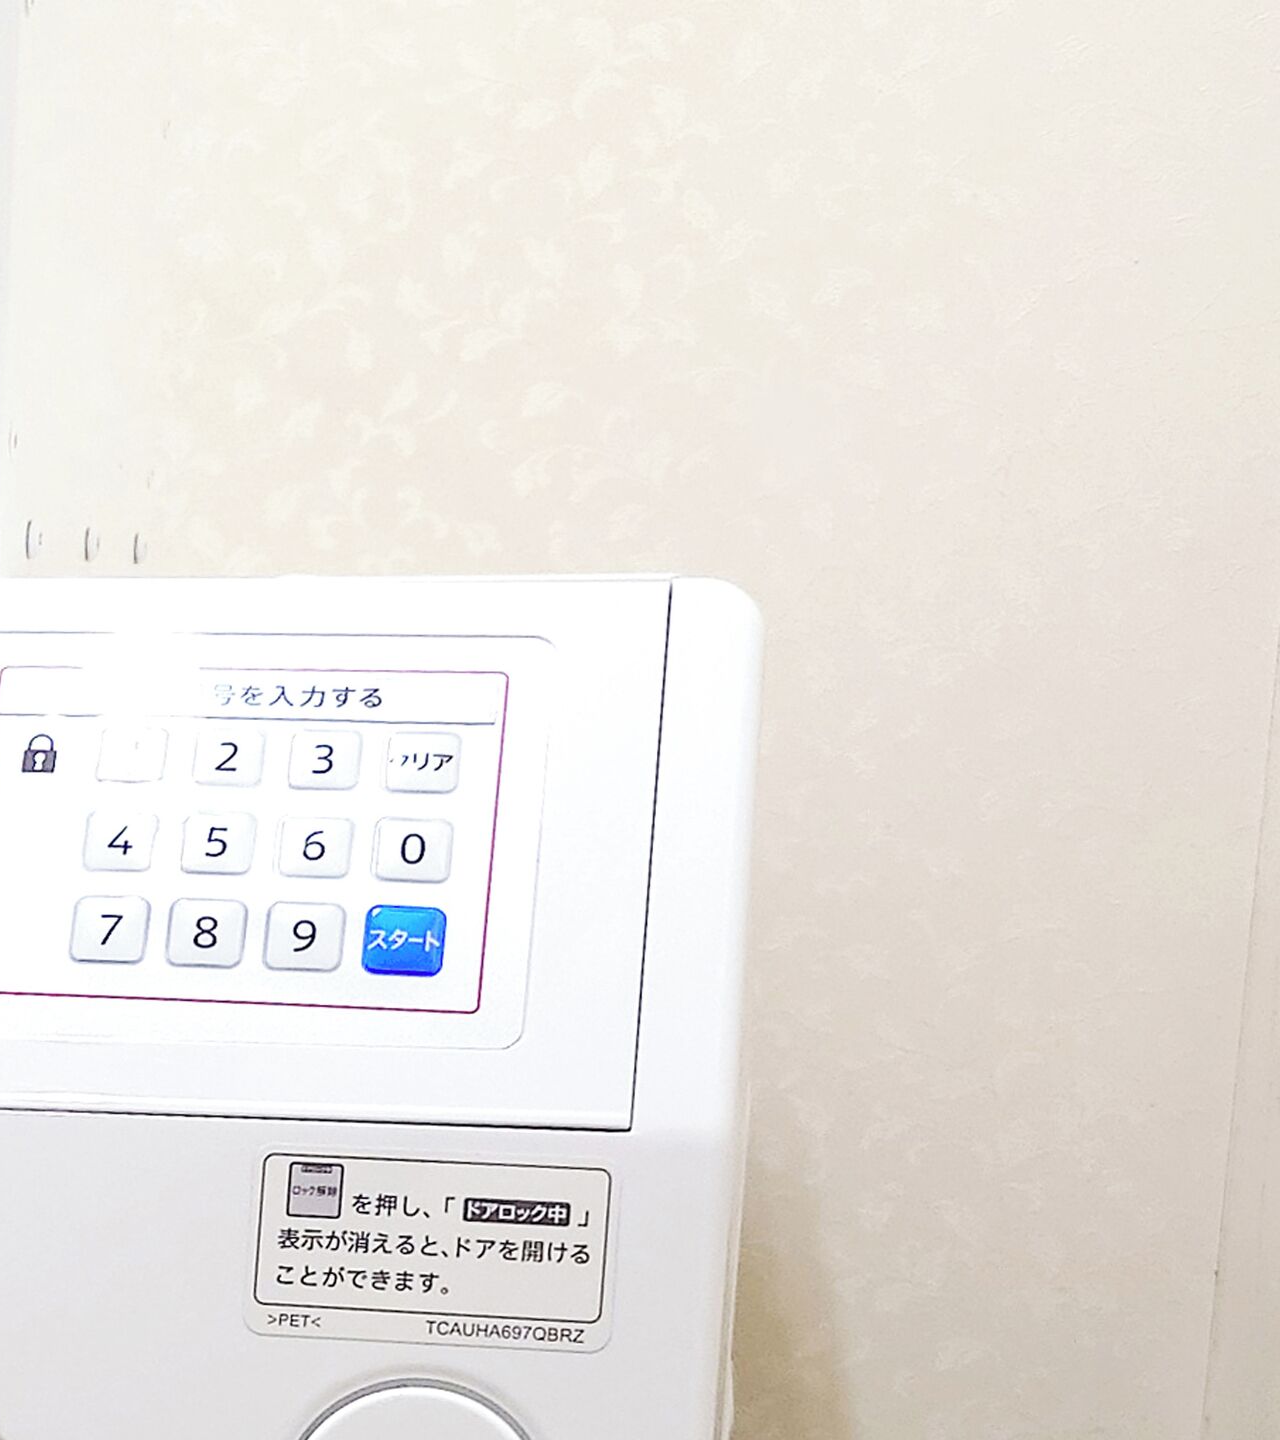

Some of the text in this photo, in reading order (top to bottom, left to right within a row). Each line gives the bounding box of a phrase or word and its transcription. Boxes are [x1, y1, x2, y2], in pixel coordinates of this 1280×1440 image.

[215, 741, 239, 772] 2
[312, 744, 335, 775] 3
[106, 825, 133, 855] 4
[204, 827, 229, 857] 5
[302, 830, 326, 860] 6
[400, 834, 426, 865] 0
[99, 914, 124, 946] 7
[193, 916, 219, 949] 8
[292, 919, 318, 952] 9
[366, 929, 441, 953] スタート
[277, 1228, 591, 1265] 表示が消えると、ドアを開ける
[276, 1264, 450, 1296] ことができます。
[425, 1320, 586, 1345] TCAUHA697QBRZ
